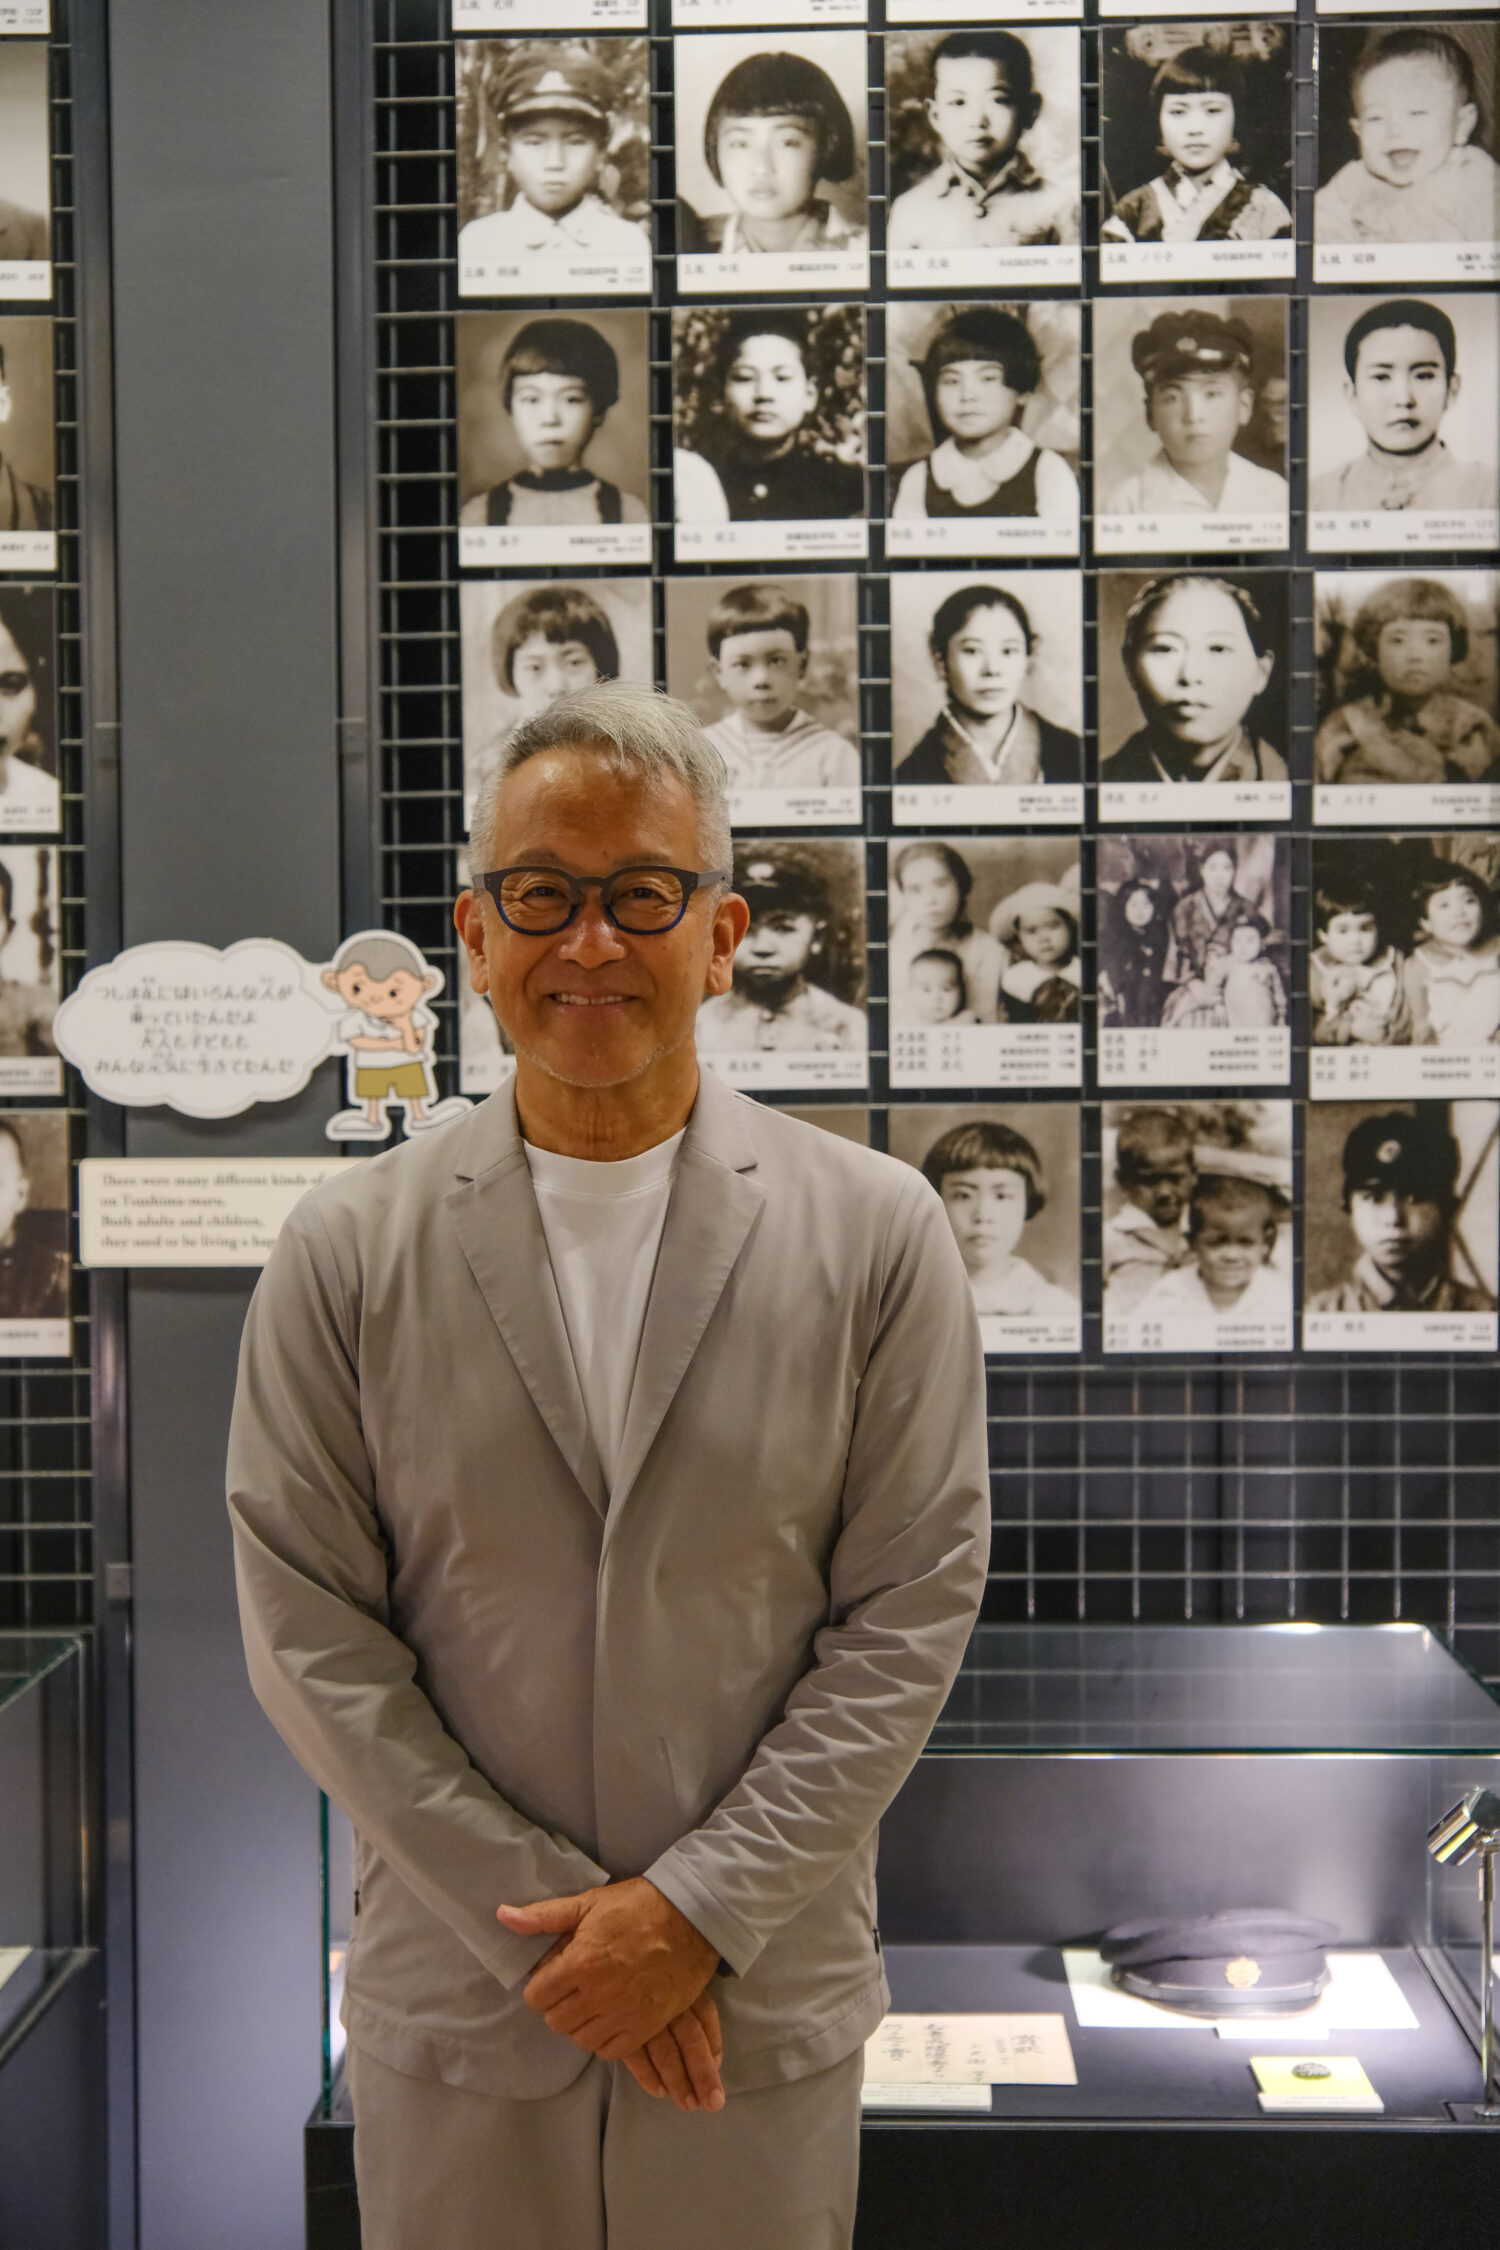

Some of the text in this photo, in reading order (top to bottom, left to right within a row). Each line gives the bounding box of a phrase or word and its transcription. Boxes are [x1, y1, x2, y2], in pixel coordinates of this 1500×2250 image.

[101, 1172, 137, 1186] There
[141, 1175, 170, 1186] were
[174, 1175, 209, 1190] many
[213, 1172, 267, 1186] different
[270, 1172, 307, 1186] kinds
[100, 1197, 117, 1207] on
[101, 1214, 132, 1227] Both
[136, 1214, 175, 1227] adults
[179, 1214, 202, 1227] and
[101, 1234, 128, 1249] they
[132, 1235, 161, 1247] used
[165, 1237, 178, 1247] to
[182, 1235, 197, 1247] be
[201, 1234, 238, 1250] living
